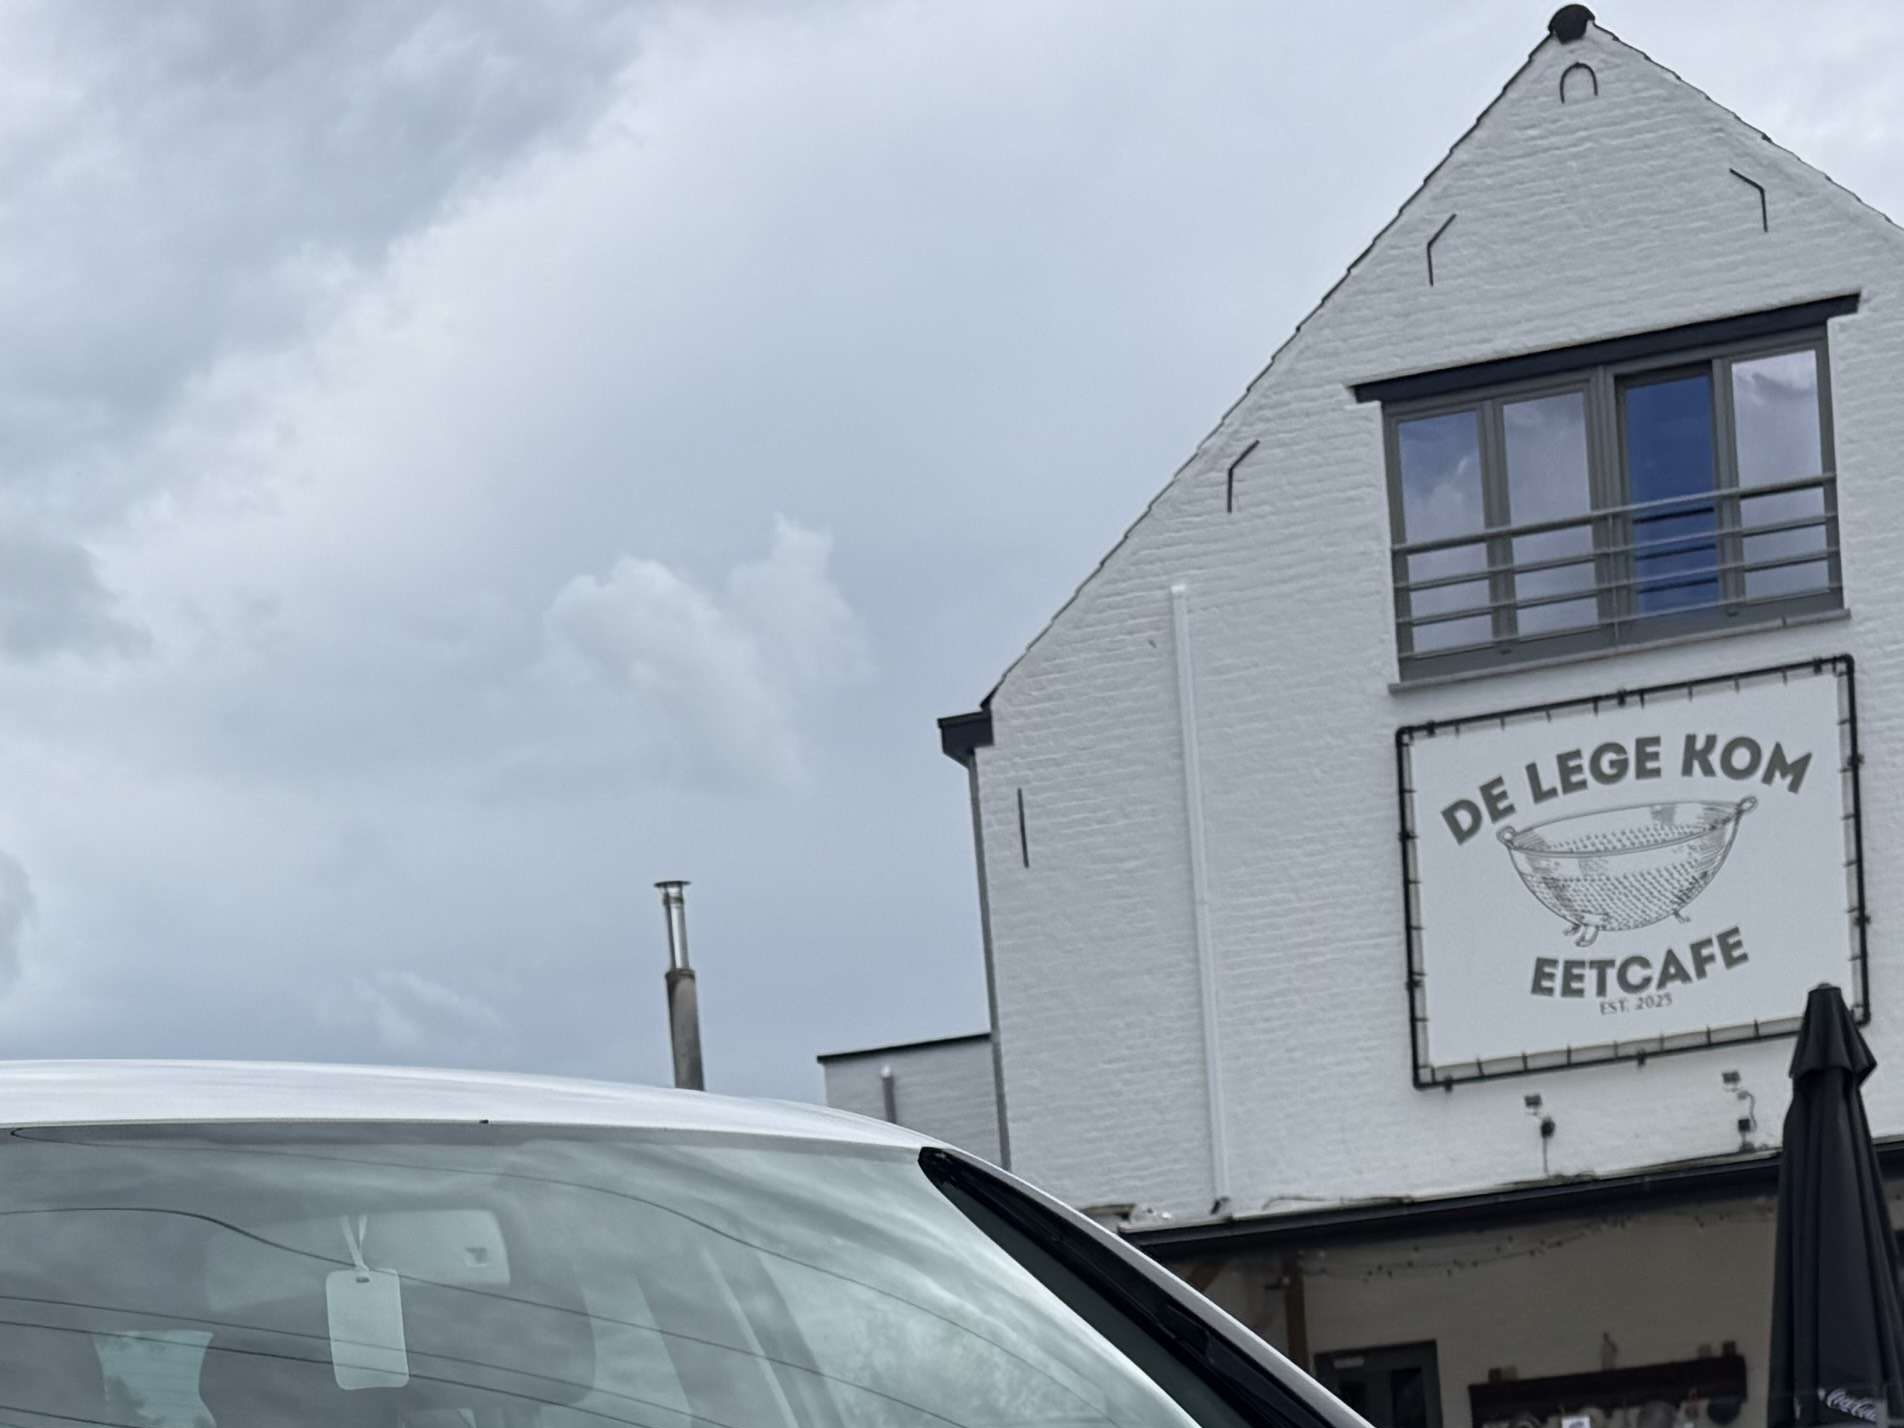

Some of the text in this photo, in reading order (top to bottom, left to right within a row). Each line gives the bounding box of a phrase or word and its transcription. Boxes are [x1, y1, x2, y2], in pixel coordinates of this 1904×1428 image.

[1441, 733, 1813, 846] DE LEGE KOM
[1530, 926, 1749, 998] EETCAFE
